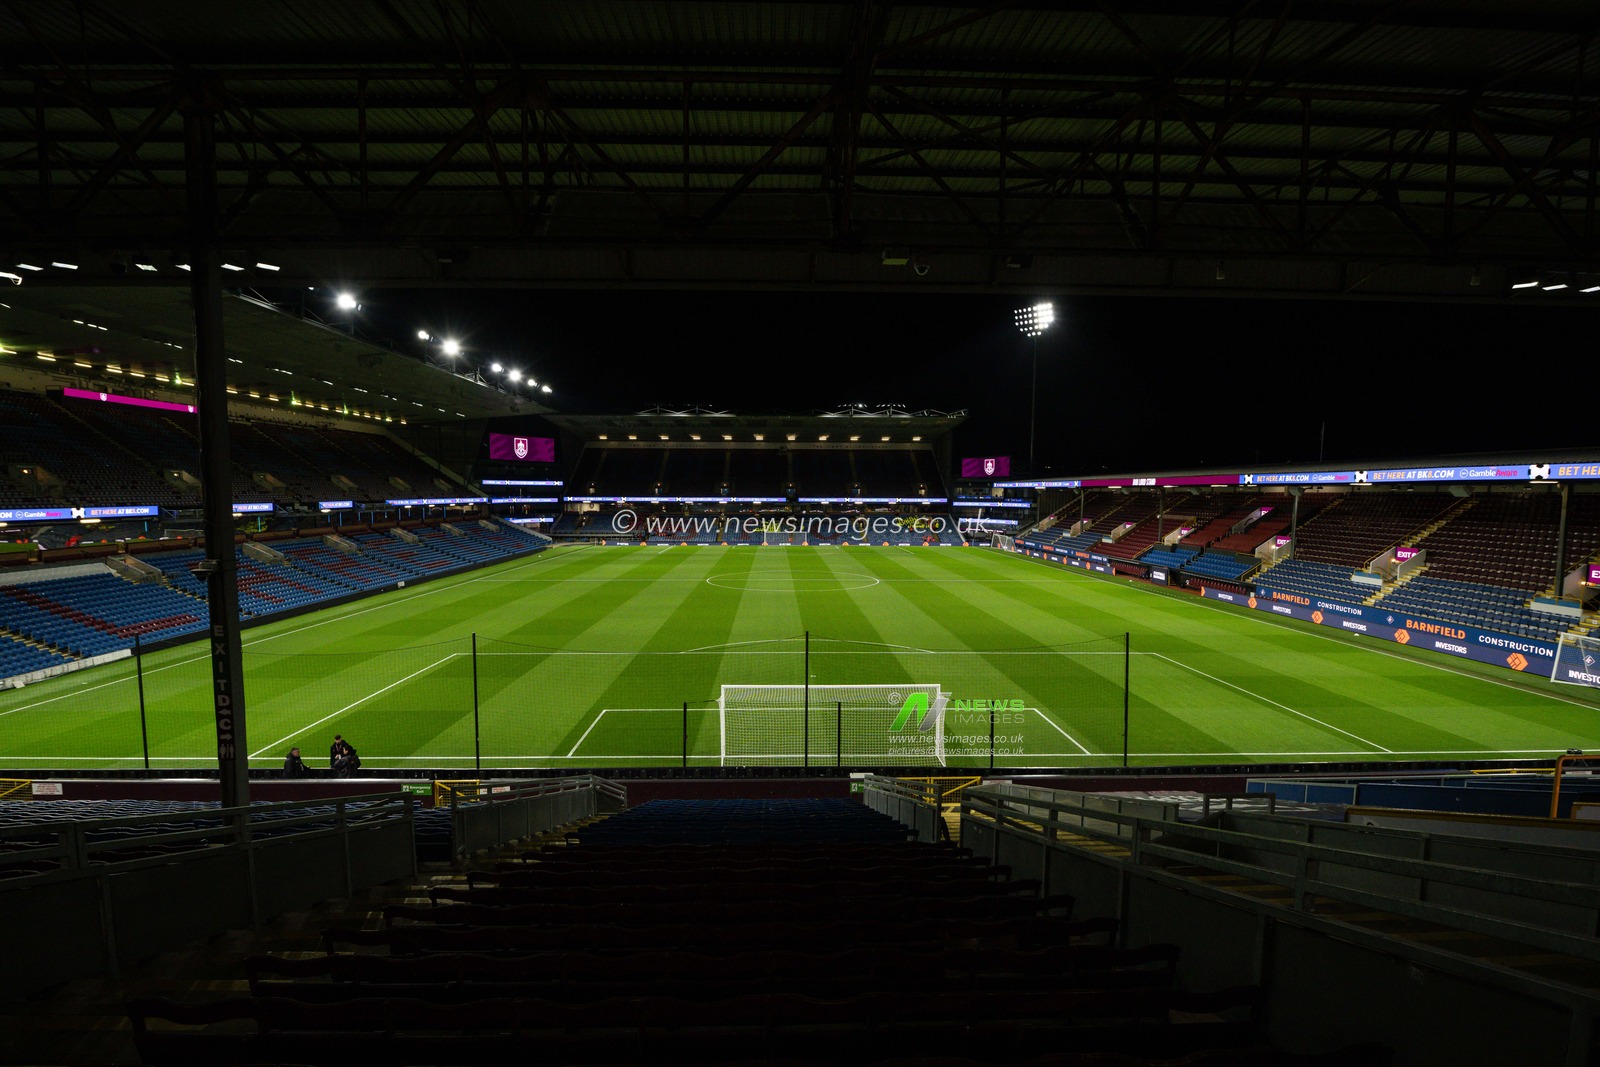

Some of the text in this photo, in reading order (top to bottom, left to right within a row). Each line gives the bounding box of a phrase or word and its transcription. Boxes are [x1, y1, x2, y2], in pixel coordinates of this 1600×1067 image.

[1373, 469, 1518, 480] BET HERE AT BK8.COM GambleAware
[1558, 466, 1580, 476] BET
[1397, 551, 1411, 559] EXIT
[1272, 591, 1362, 616] BARNFIELD CONSTRUCTION
[1342, 620, 1367, 632] INVESTORS
[1405, 619, 1553, 658] BARNFIELD CONSTRUCTION
[1435, 640, 1467, 654] INVESTORS
